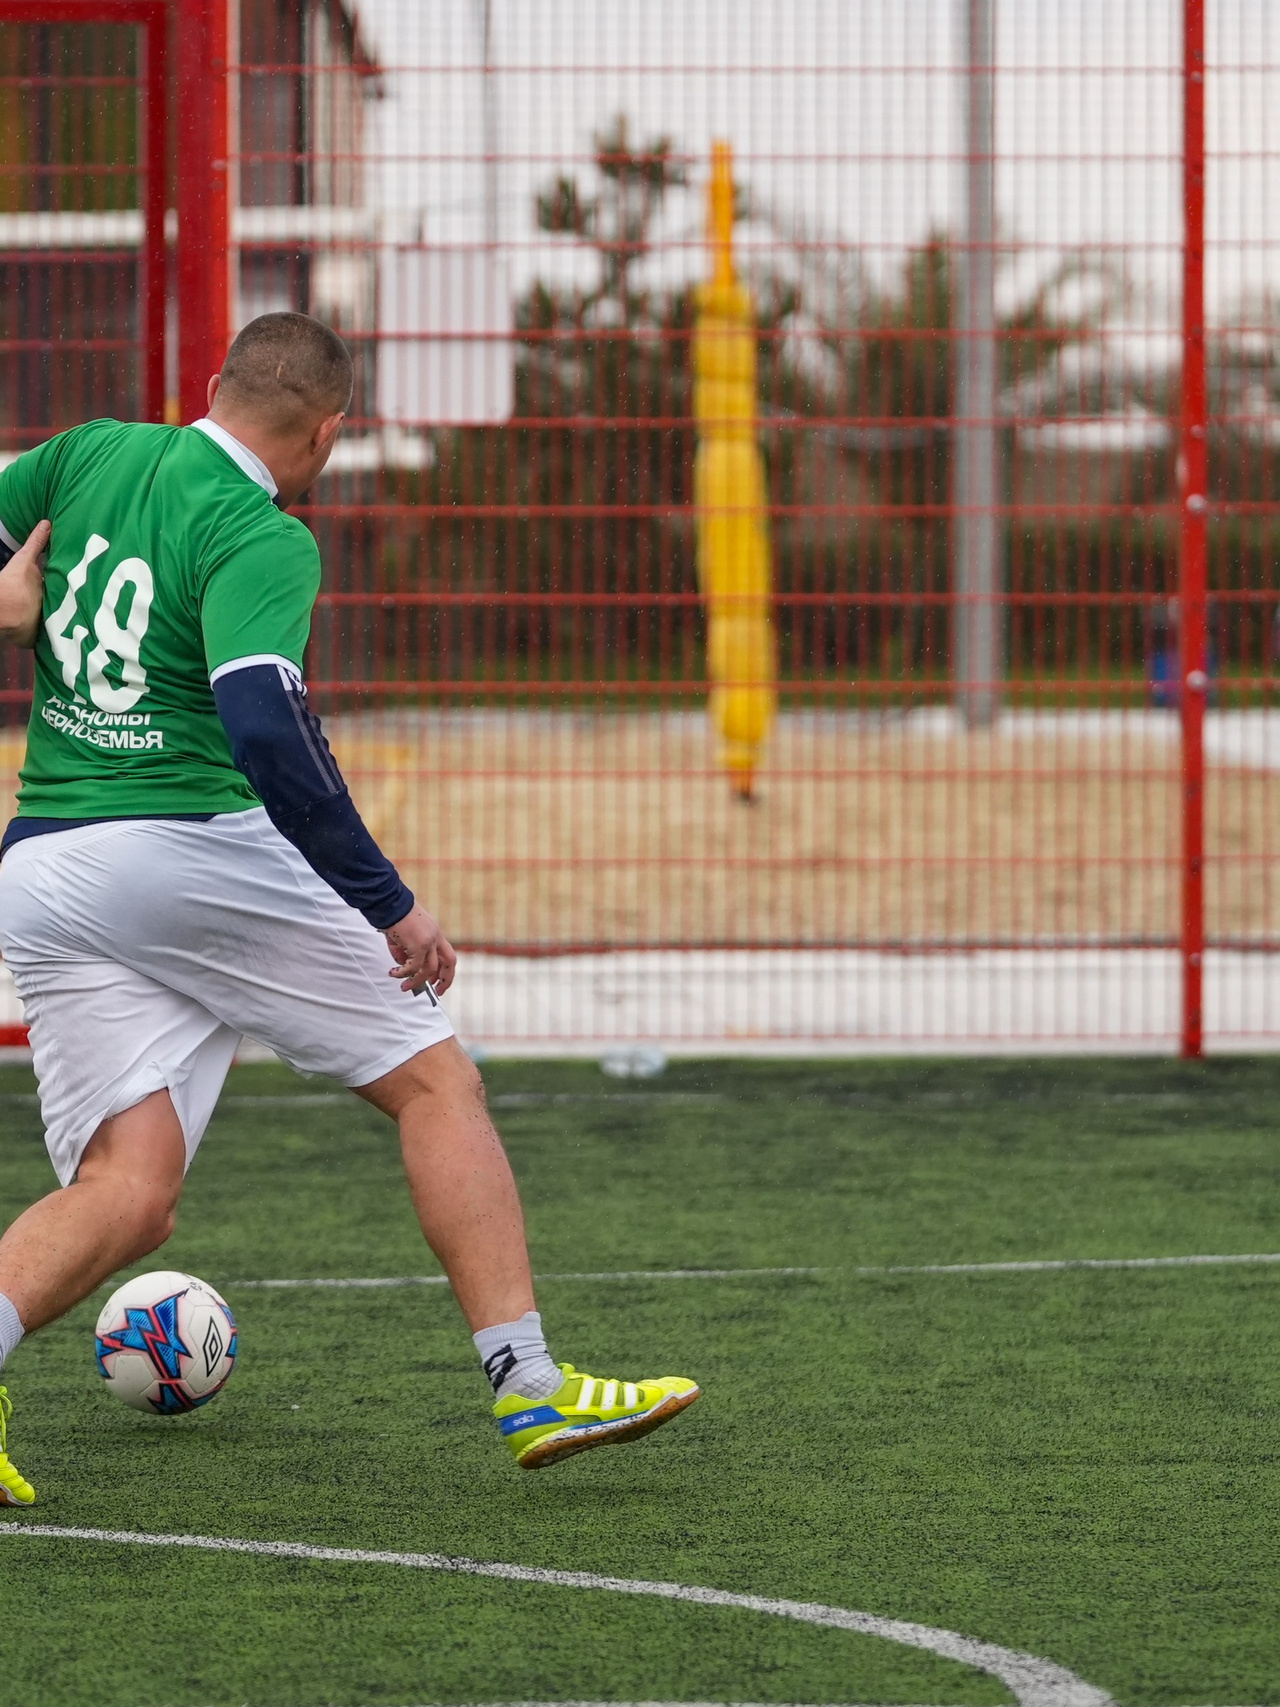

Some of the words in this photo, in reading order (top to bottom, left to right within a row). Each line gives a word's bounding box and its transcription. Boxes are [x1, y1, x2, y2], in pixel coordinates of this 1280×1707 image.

[45, 533, 154, 714] 48
[41, 705, 163, 749] ЧЕРНОЗЕМЬЯ
[46, 695, 151, 726] АГОНОМЫ
[512, 1414, 535, 1427] sala
